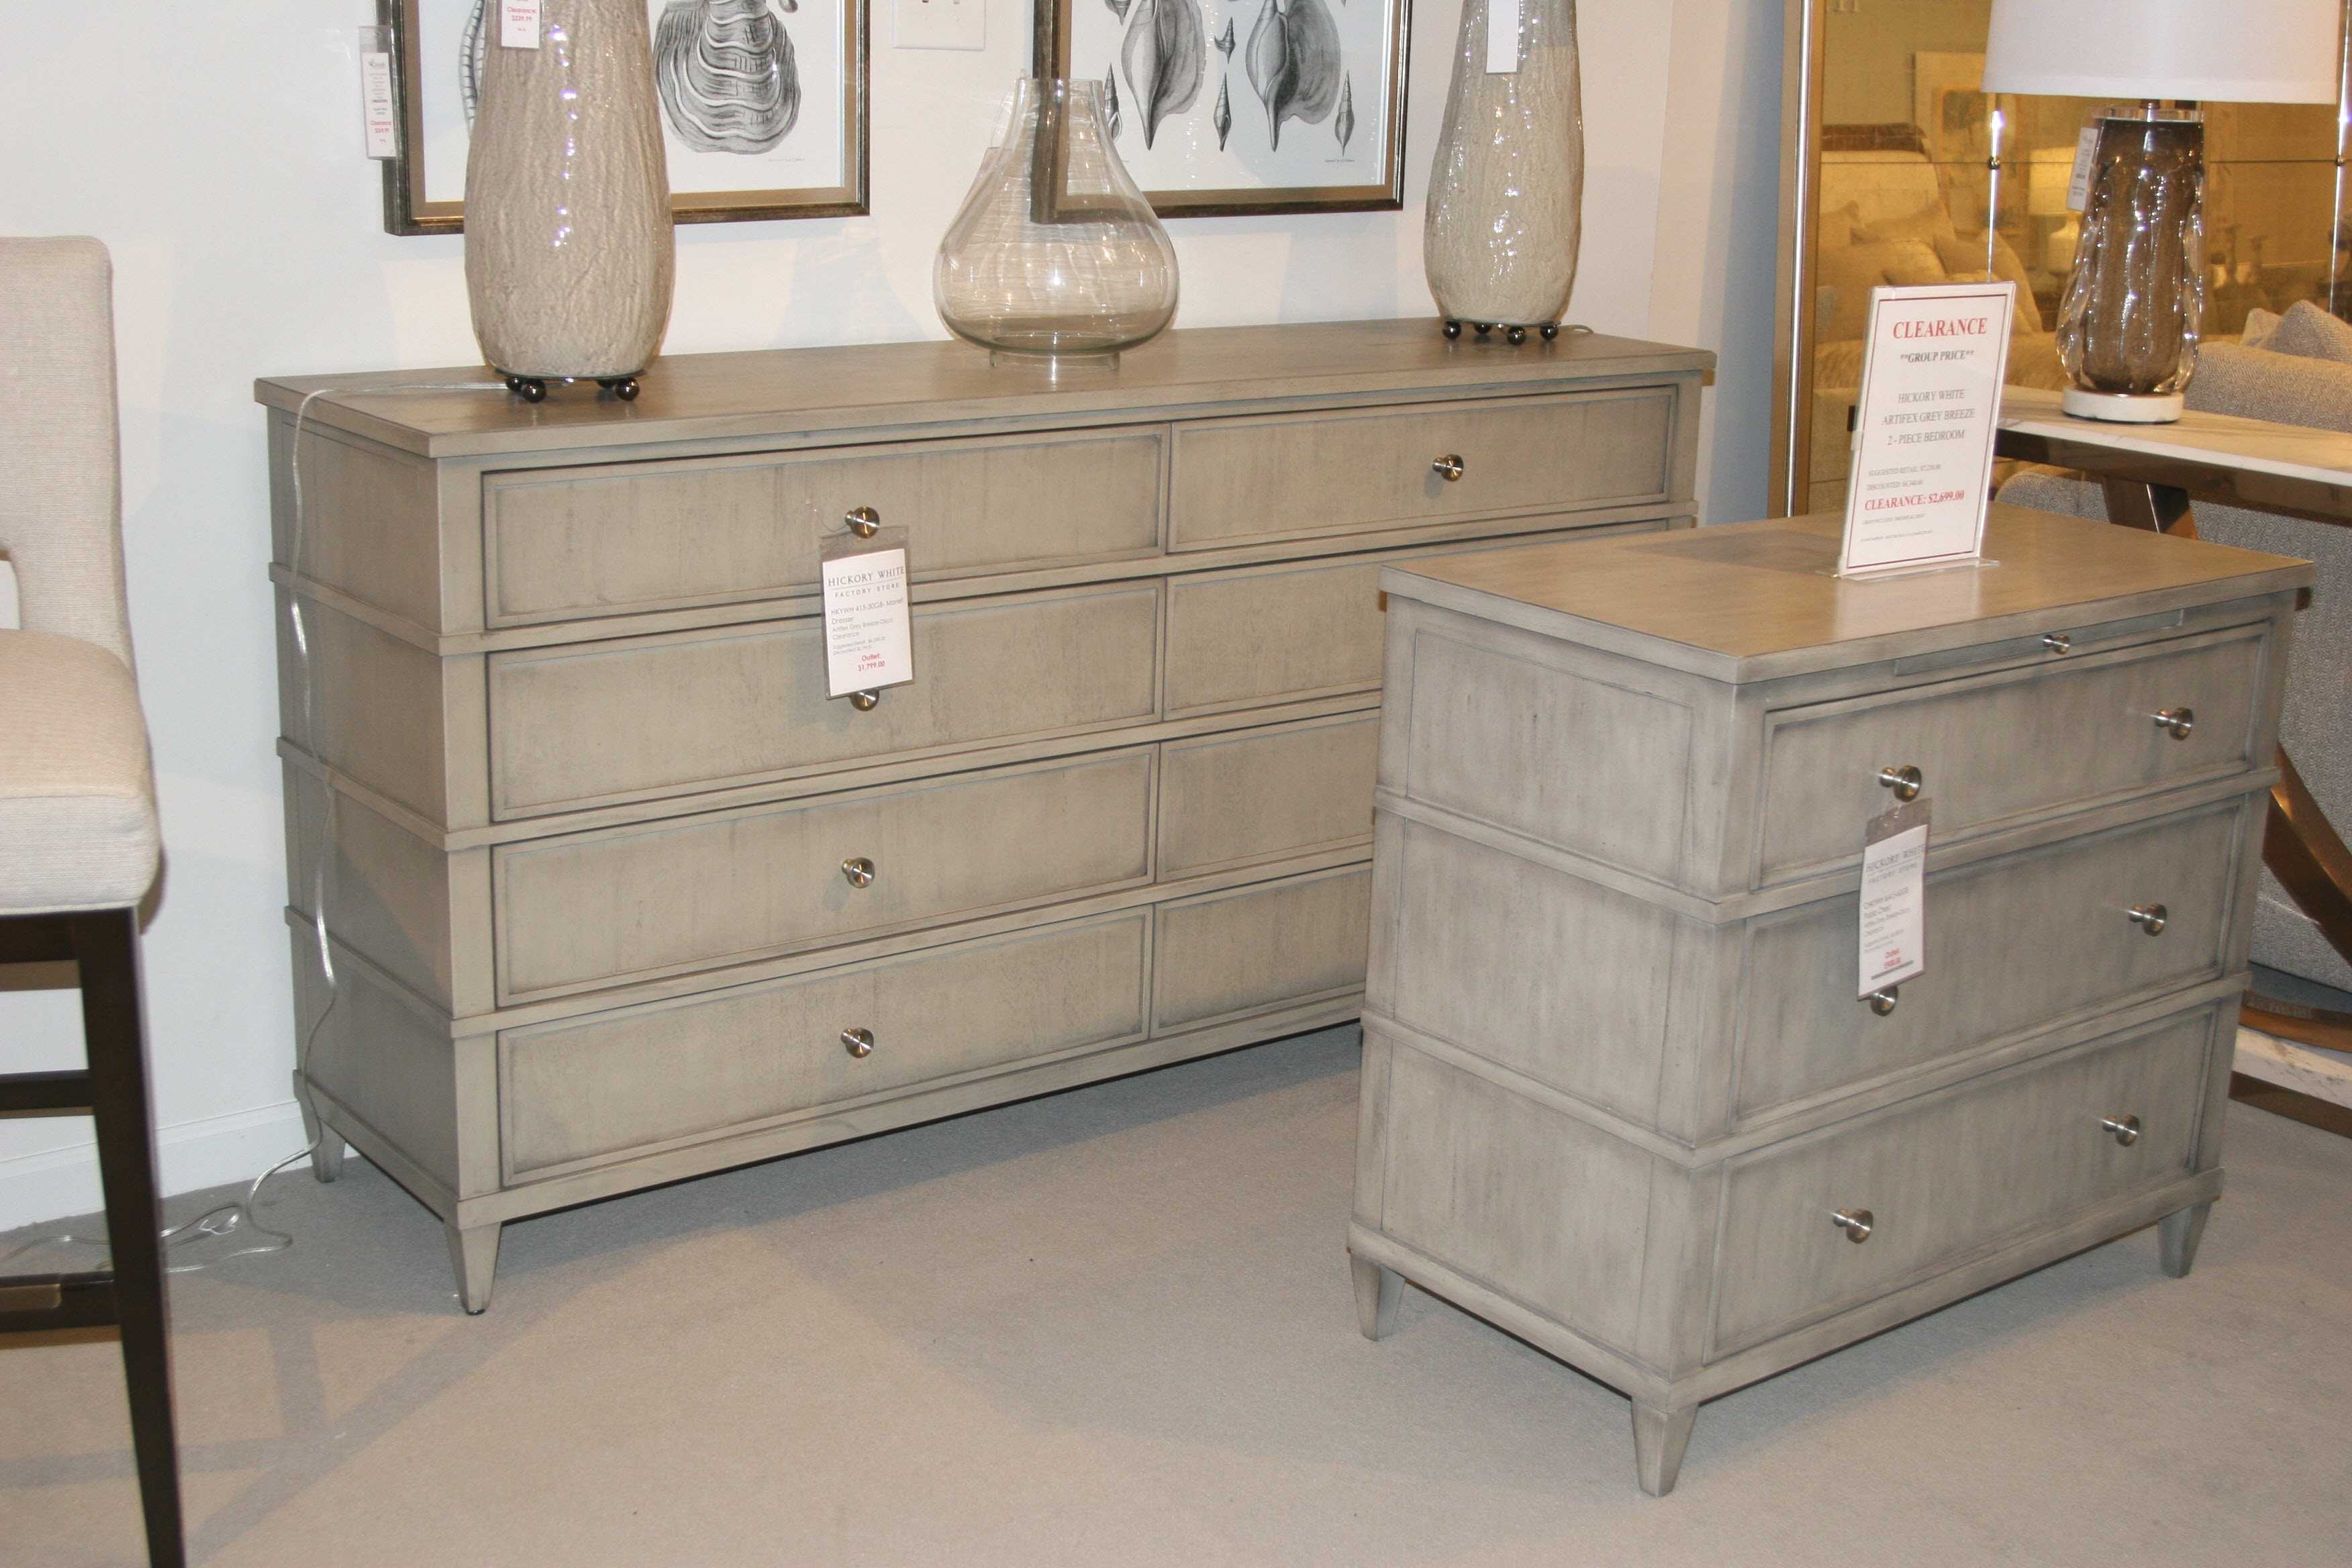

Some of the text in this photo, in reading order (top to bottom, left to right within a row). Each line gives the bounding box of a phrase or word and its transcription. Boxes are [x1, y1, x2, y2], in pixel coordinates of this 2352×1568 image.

[1893, 317, 1988, 339] CLEARANCE
[1898, 389, 1965, 403] HICKORY WHITE
[1881, 408, 1975, 426] ARTIFEX GREY BREEZE
[1888, 435, 1892, 446] 2
[1898, 432, 1922, 444] PIECE
[1924, 429, 1965, 442] BEDROOM
[1865, 490, 1965, 511] CLEARANCE: $2,699.00
[828, 566, 904, 587] HICKORY WHITE
[835, 582, 899, 598] FACTORY STORE
[886, 597, 904, 607] Monet
[832, 616, 854, 625] Dresser
[849, 622, 861, 631] Grey
[832, 632, 860, 640] Clearance
[861, 652, 881, 662] Outlet:
[858, 660, 885, 672] $1,799.00
[1865, 853, 1900, 873] HICKORY
